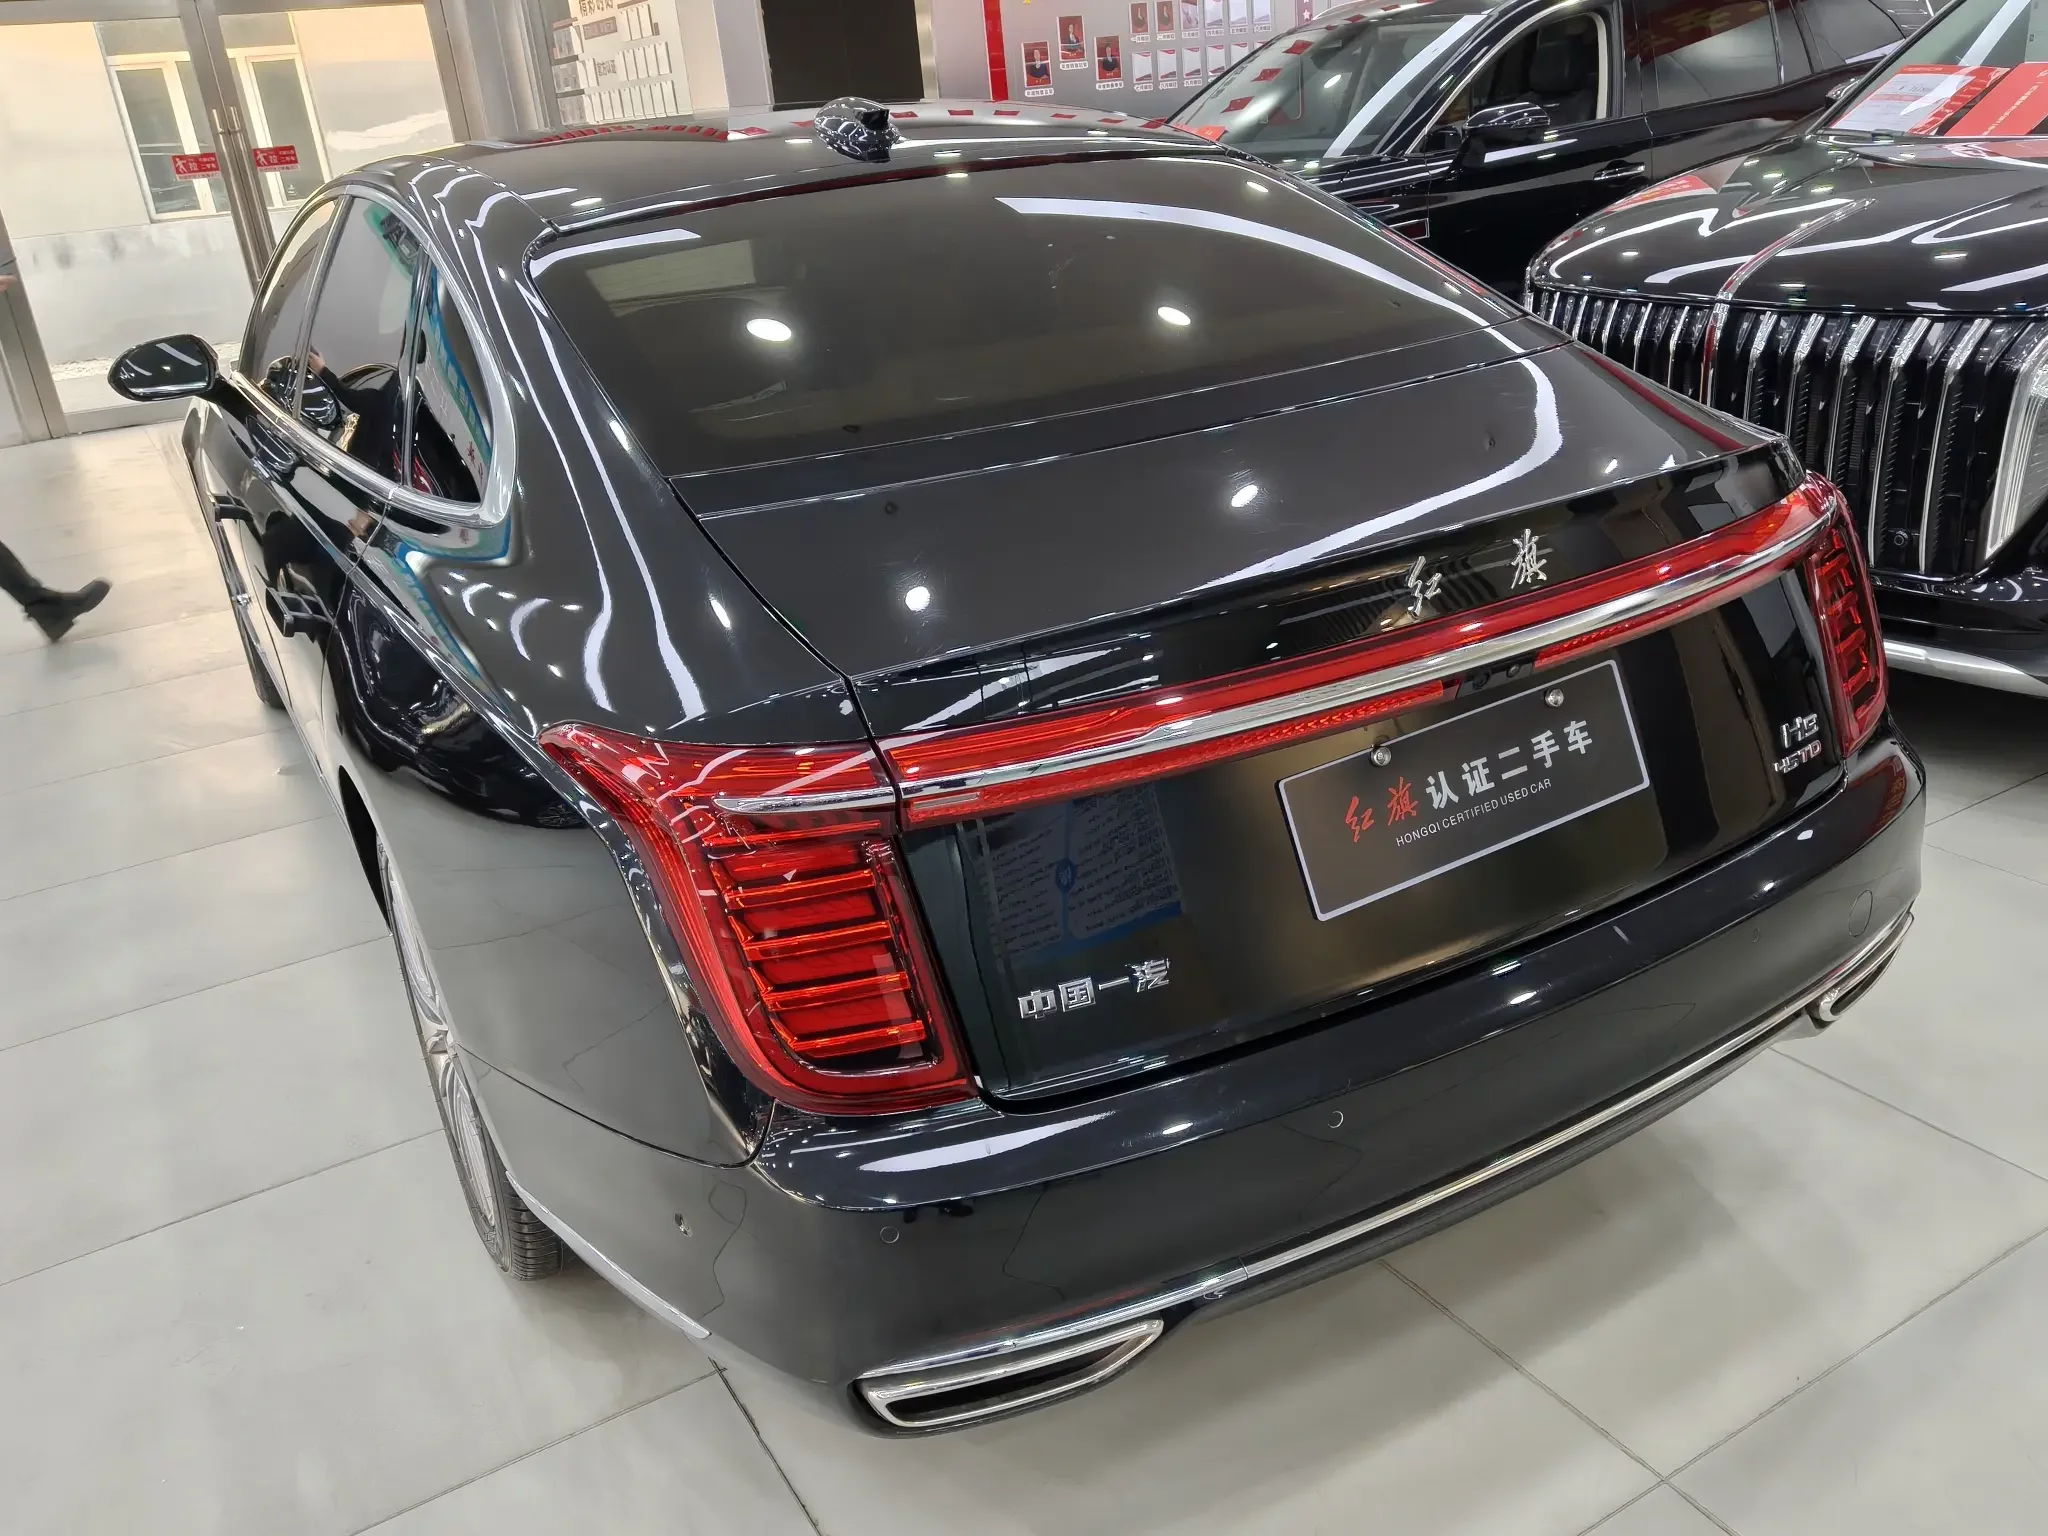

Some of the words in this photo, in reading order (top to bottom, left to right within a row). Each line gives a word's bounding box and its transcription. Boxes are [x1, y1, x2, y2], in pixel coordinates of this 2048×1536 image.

[1405, 529, 1547, 619] 红旗
[1396, 824, 1441, 847] HONGQI
[1442, 799, 1499, 828] CERTIFIED
[1500, 787, 1529, 806] USED
[1530, 778, 1552, 793] CAR
[1018, 958, 1171, 1019] 中国一汽
